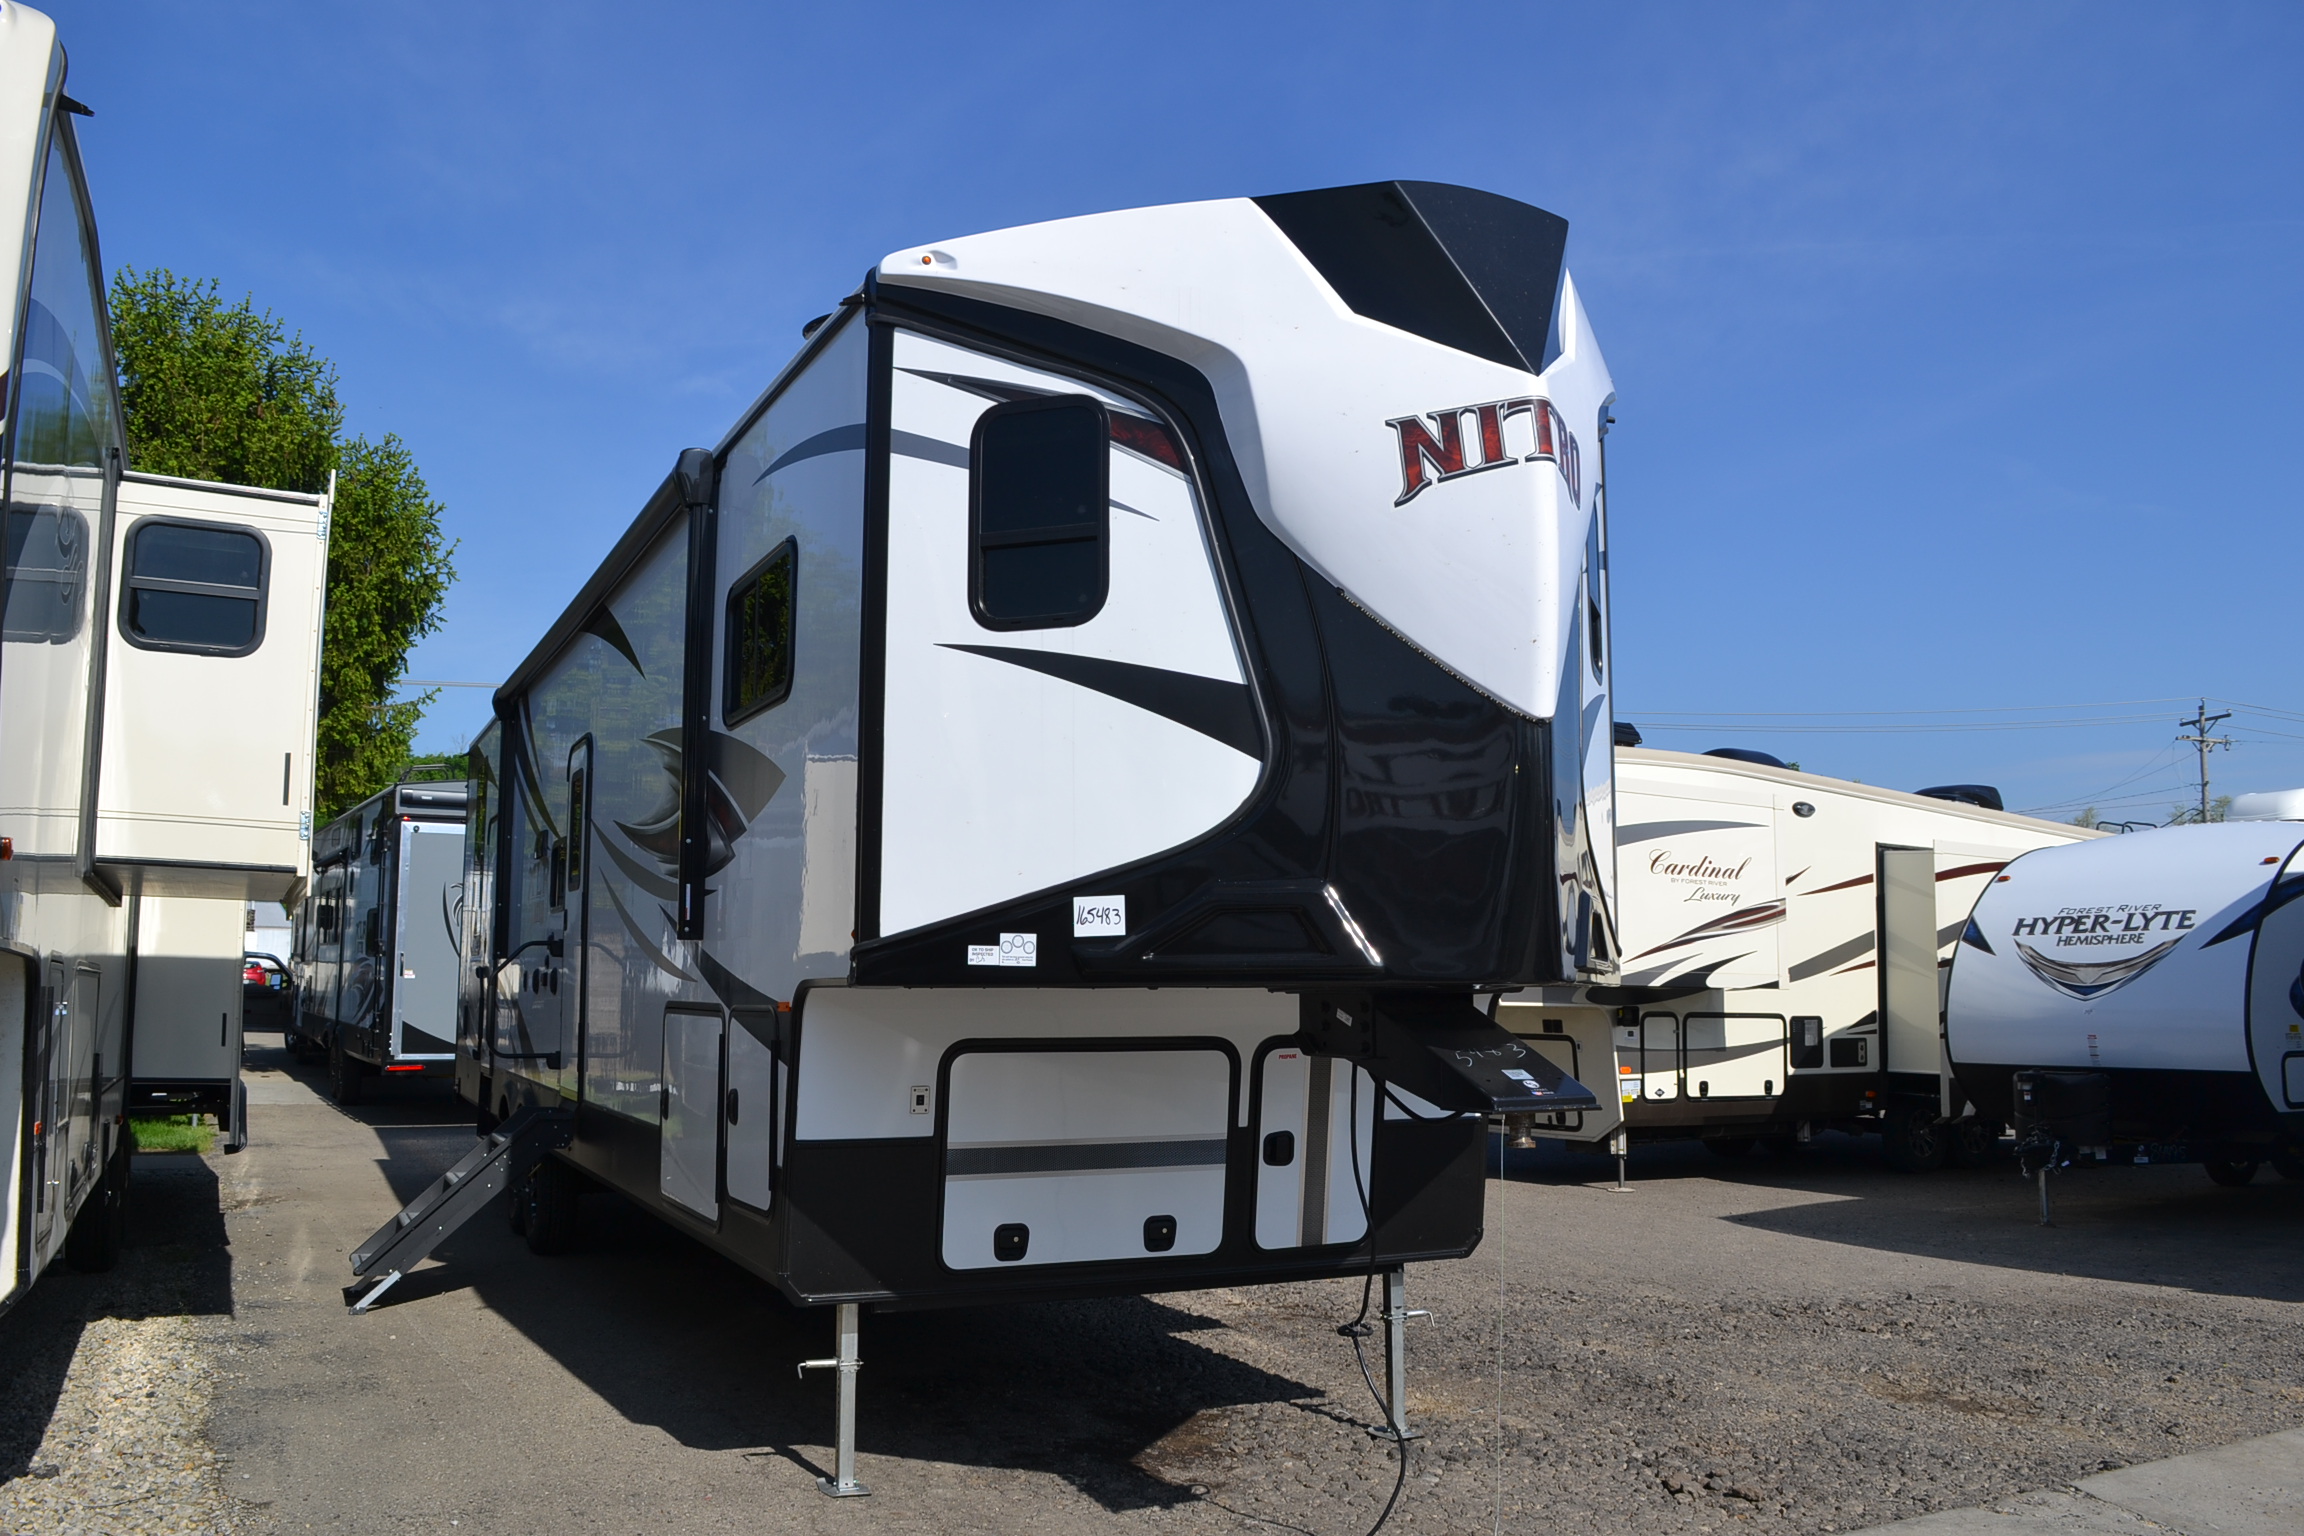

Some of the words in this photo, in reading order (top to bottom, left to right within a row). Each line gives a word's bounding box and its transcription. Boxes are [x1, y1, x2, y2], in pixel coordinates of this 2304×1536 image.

[1649, 848, 1752, 880] Cardinal
[1681, 878, 1707, 886] FOREST
[1683, 886, 1741, 907] Luxury
[1076, 905, 1122, 926] 165483
[2057, 906, 2114, 916] FOREST
[2116, 903, 2162, 913] RIVER
[2012, 909, 2197, 937] HYPER-LYTE
[2056, 932, 2145, 947] HEMISPHERE
